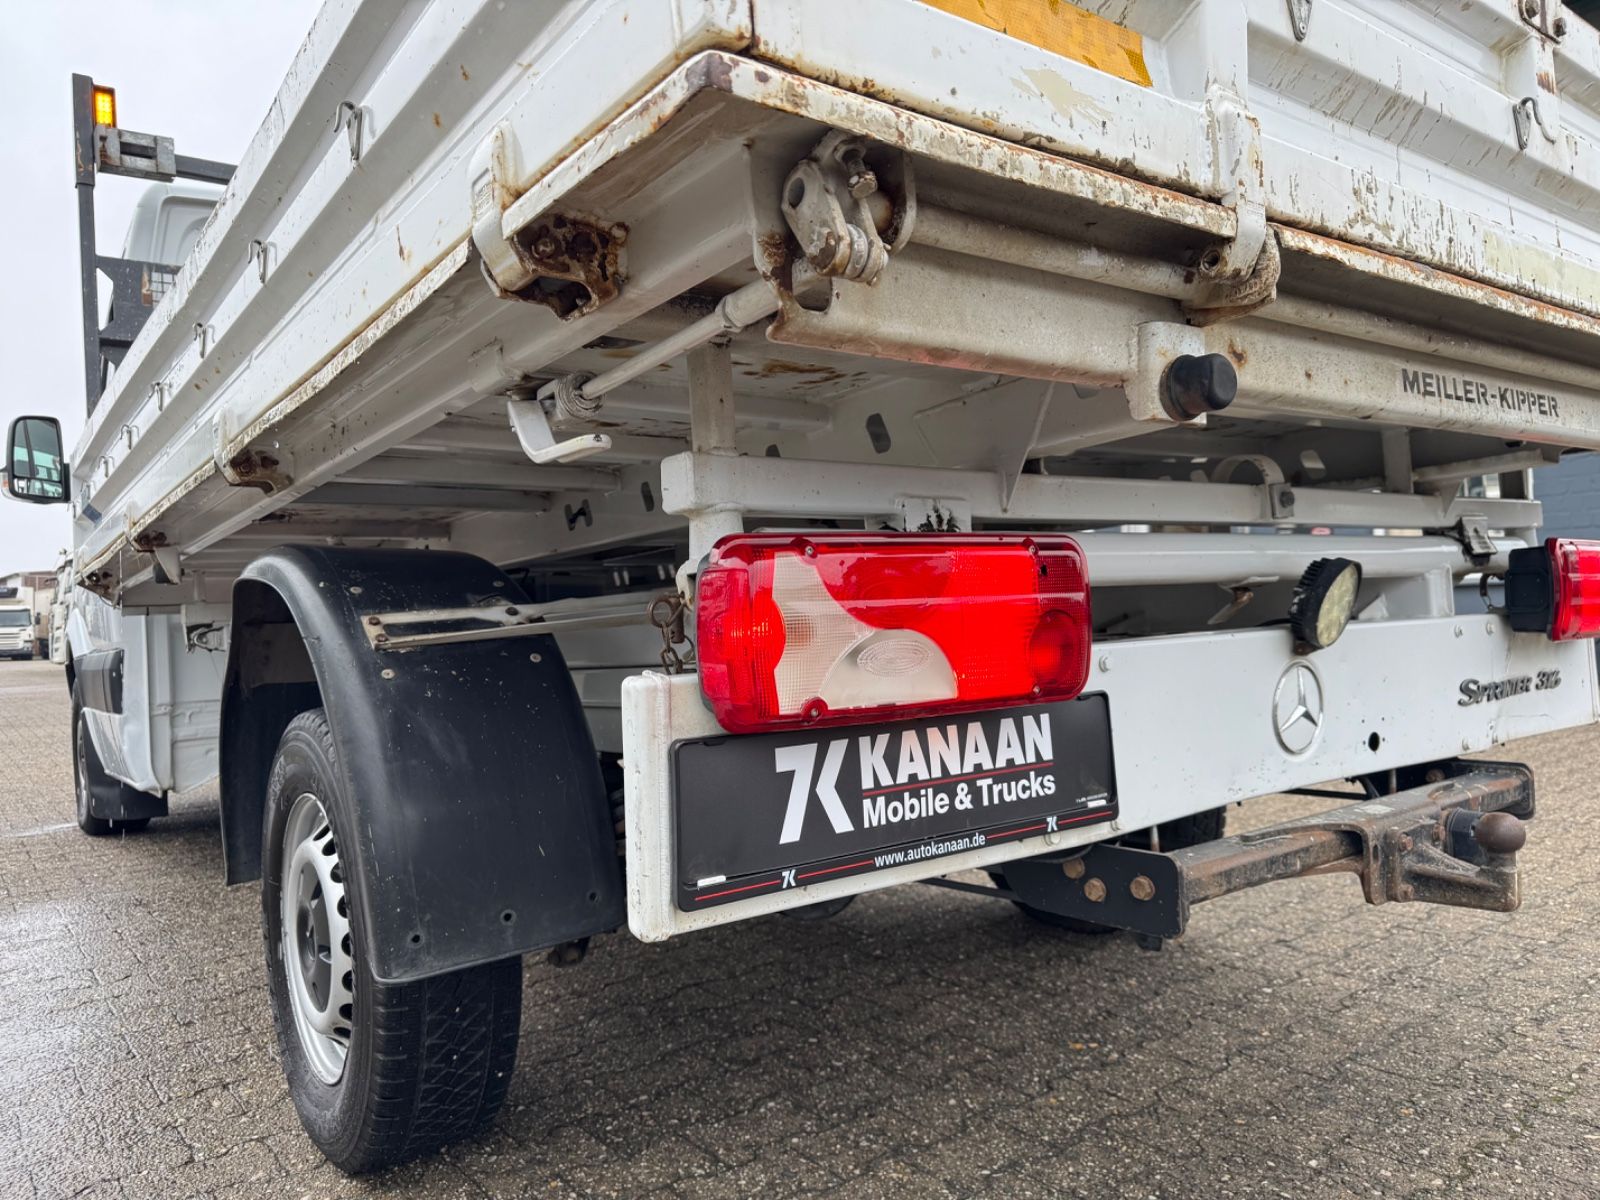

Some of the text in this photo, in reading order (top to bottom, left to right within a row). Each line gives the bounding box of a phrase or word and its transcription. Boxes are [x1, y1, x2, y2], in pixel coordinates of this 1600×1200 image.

[1401, 368, 1560, 418] MEILLER-KIPPER
[858, 713, 1054, 790] KANAAN
[863, 771, 1056, 829] Mobile & Trucks
[874, 832, 986, 868] www.autokanaan.de
